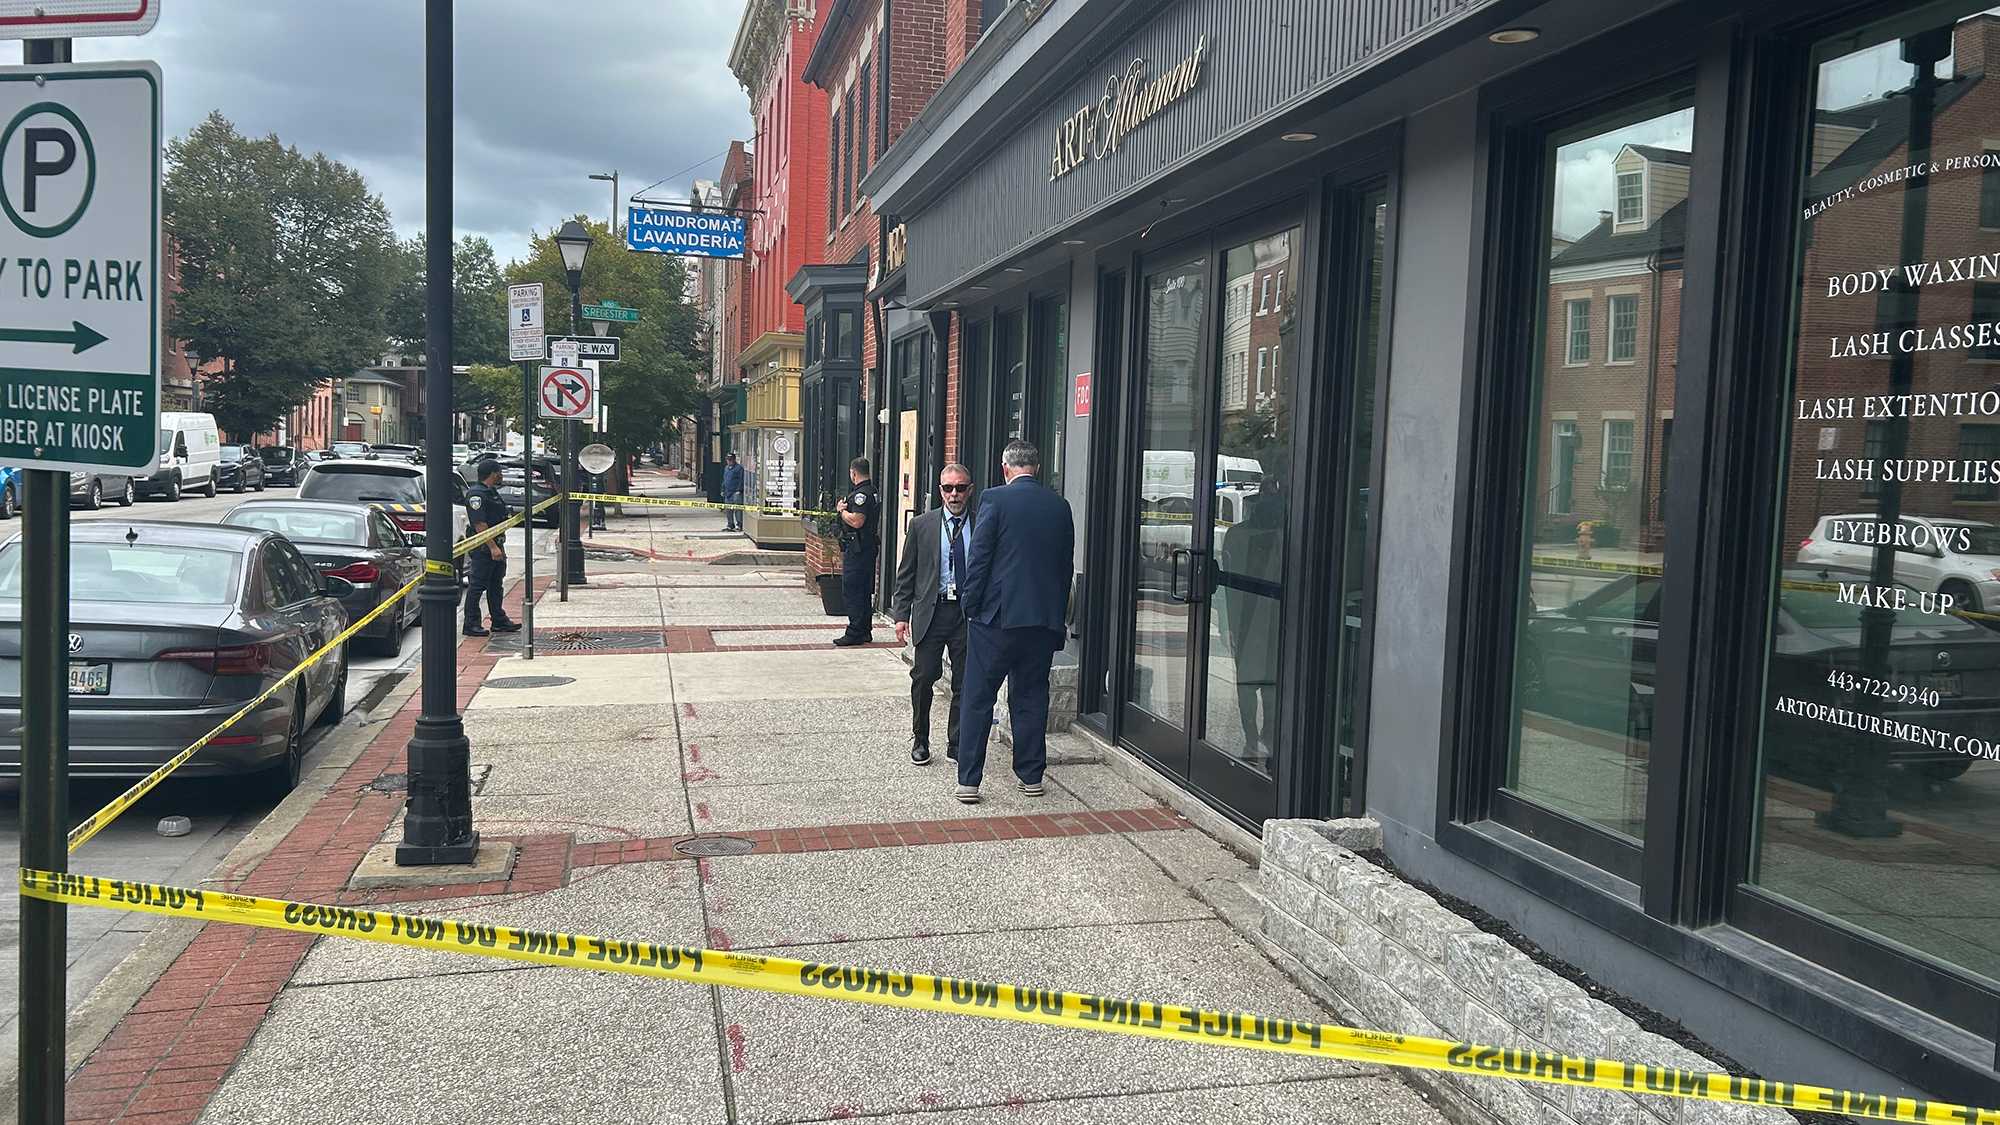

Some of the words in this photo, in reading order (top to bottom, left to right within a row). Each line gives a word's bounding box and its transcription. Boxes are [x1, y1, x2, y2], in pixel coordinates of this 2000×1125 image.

[1049, 105, 1089, 181] ART
[1094, 33, 1206, 160] Allurement
[24, 128, 76, 212] P
[1803, 186, 1855, 221] BEAUTY,
[1858, 162, 1927, 194] COSMETIC
[1930, 162, 1940, 173] &
[633, 212, 738, 233] LAUNDROMAT
[633, 229, 739, 249] LAVANDERÍA
[17, 258, 51, 298] TO
[64, 258, 143, 301] PARK
[1827, 267, 1896, 298] BODY
[1903, 252, 2000, 287] WAXIN
[514, 288, 538, 297] PARKING
[578, 344, 588, 353] NE
[591, 344, 612, 353] WAY
[1830, 332, 1890, 358] LASH
[7, 383, 81, 412] LICENSE
[88, 388, 143, 416] PLATE
[1798, 397, 1855, 421] LASH
[1863, 391, 2000, 418] EXTENTIO
[45, 421, 65, 447] AT
[71, 423, 124, 451] KIOSK
[1816, 459, 1874, 481] LASH
[1882, 459, 2000, 485] SUPPLIES
[1832, 520, 1971, 552] EYEBROWS
[1836, 582, 1954, 617] MAKE-UP
[70, 671, 103, 687] 9465
[1775, 696, 2000, 762] ARTOFALLUREMENT.COM
